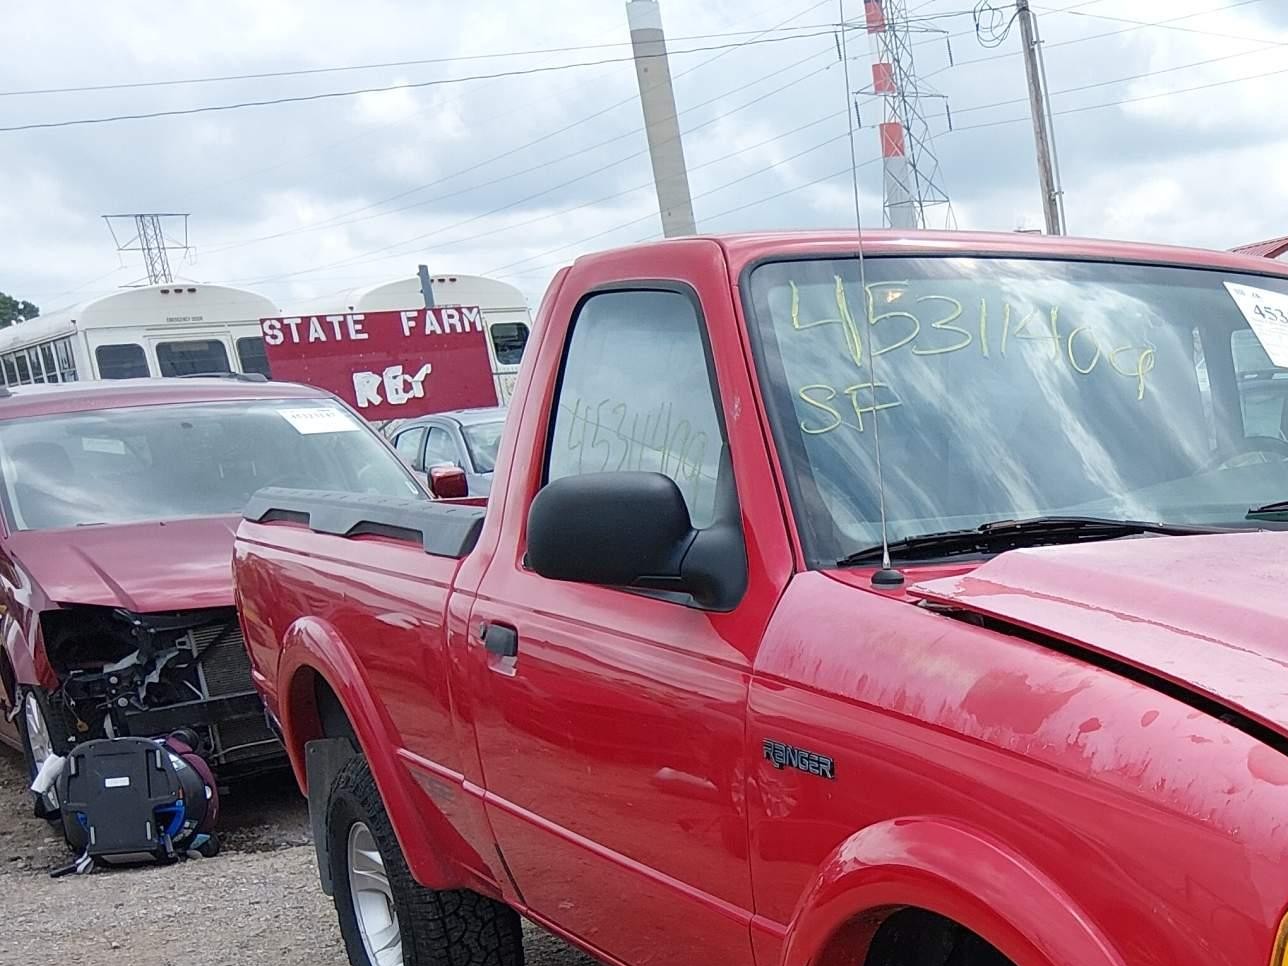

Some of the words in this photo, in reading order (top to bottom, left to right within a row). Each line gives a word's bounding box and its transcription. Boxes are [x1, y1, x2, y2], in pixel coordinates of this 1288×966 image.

[262, 314, 369, 345] STATE
[400, 307, 484, 337] FARM
[799, 384, 902, 434] SF
[763, 738, 834, 779] RANGER
